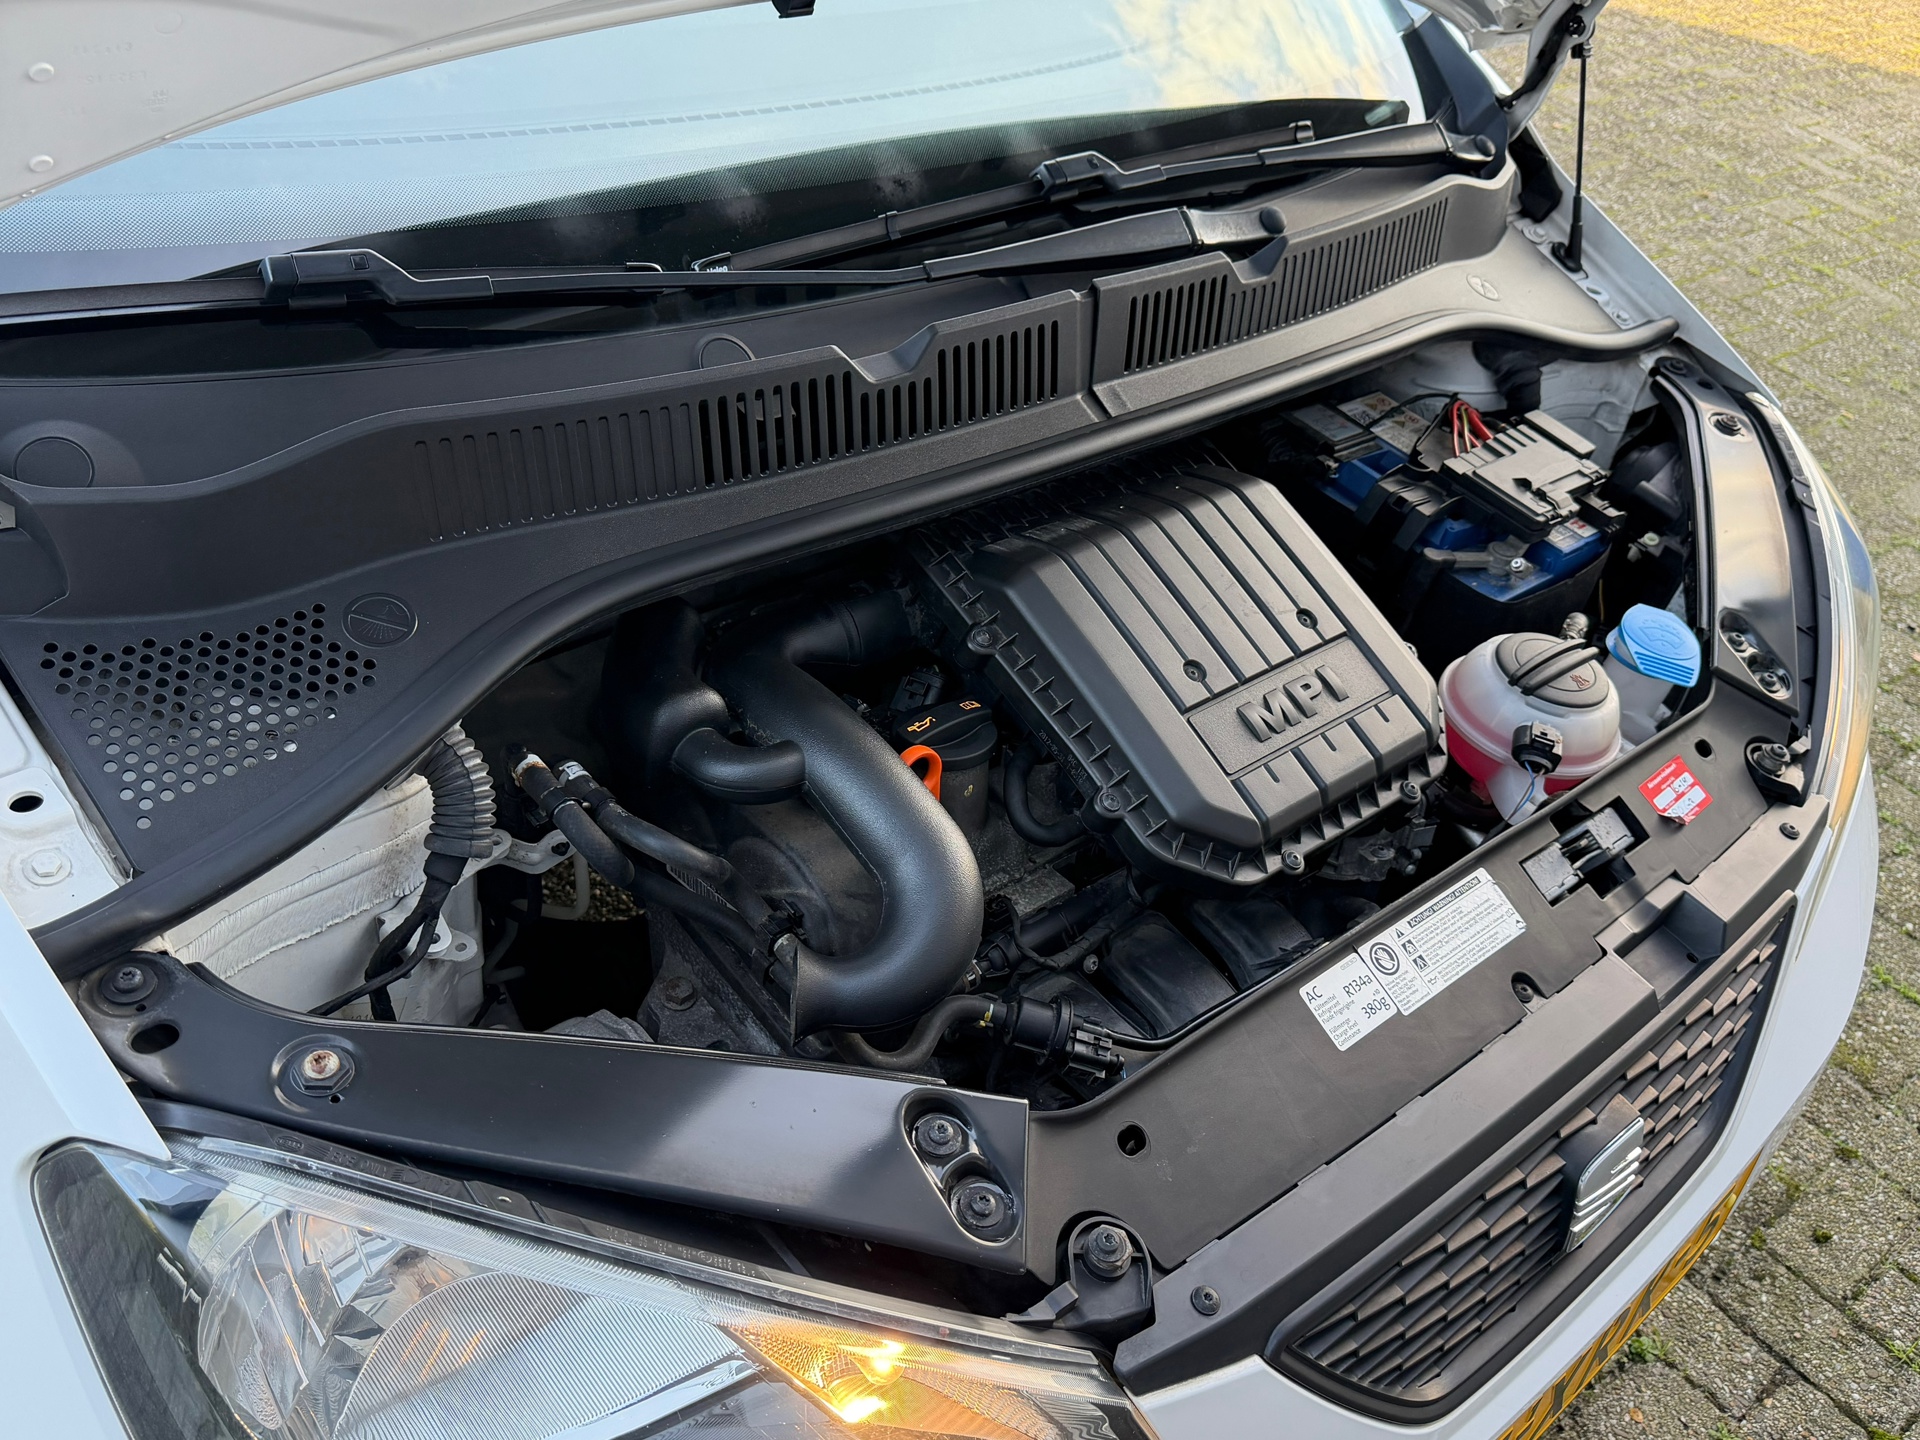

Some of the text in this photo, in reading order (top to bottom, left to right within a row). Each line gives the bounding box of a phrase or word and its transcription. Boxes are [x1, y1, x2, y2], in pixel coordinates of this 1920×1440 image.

[1237, 664, 1349, 742] MPI
[1410, 907, 1434, 927] ACHTUNG!
[1432, 893, 1456, 913] WARNING!
[1454, 877, 1480, 898] ATTENTION!
[1305, 985, 1323, 1005] AC
[1343, 973, 1373, 998] R134a
[1313, 994, 1337, 1012] Kältemittel
[1317, 1000, 1341, 1019] Refrigerant
[1361, 996, 1391, 1019] 380g
[1322, 1011, 1335, 1025] Fluide
[1329, 1017, 1351, 1035] Füllmenge
[1333, 1021, 1359, 1041] Charge level
[1337, 1028, 1362, 1047] Contenance
